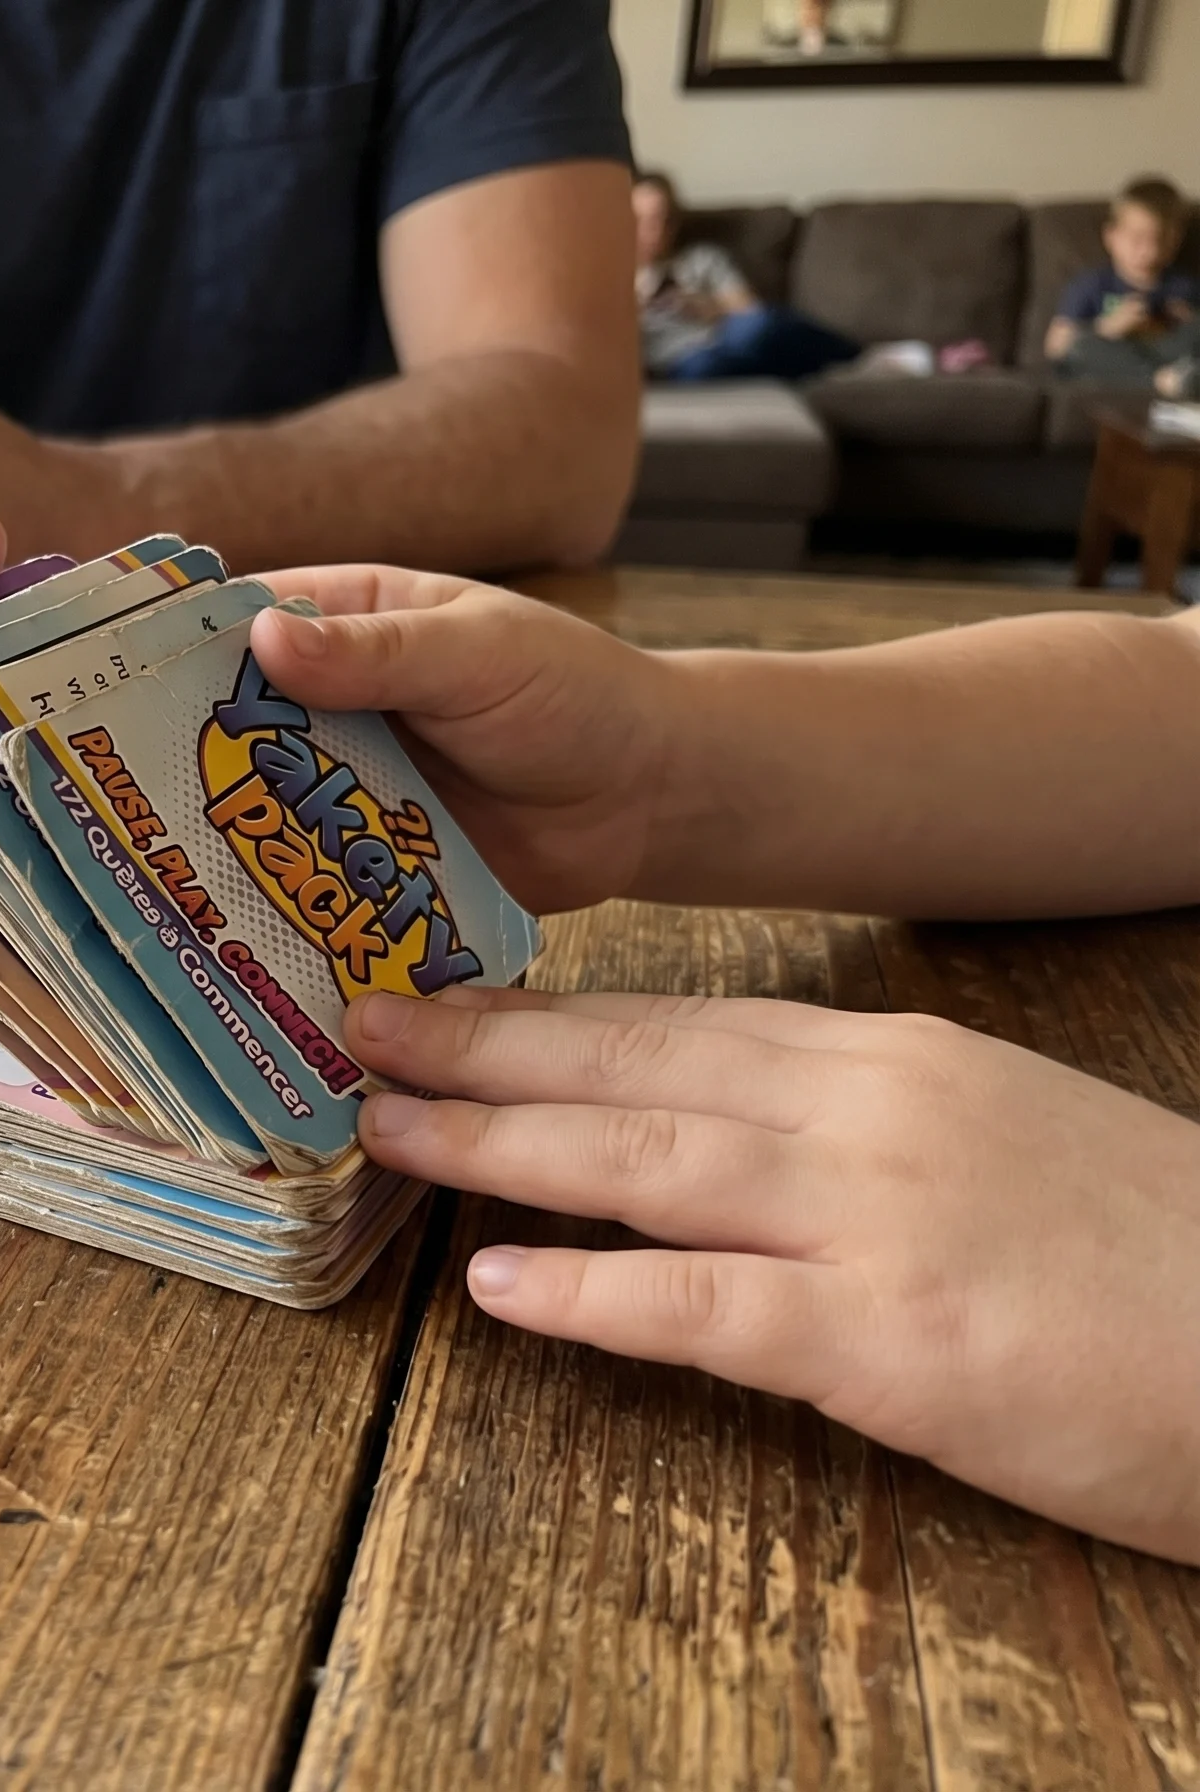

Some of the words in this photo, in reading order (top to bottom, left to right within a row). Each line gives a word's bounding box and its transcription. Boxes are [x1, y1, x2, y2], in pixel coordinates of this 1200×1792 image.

[53, 775, 93, 825] 172
[178, 947, 312, 1118] Commencer
[68, 726, 167, 851] PAUSE,
[218, 940, 364, 1093] CONNECT!
[203, 773, 389, 985] pack
[213, 648, 484, 996] Yakety
